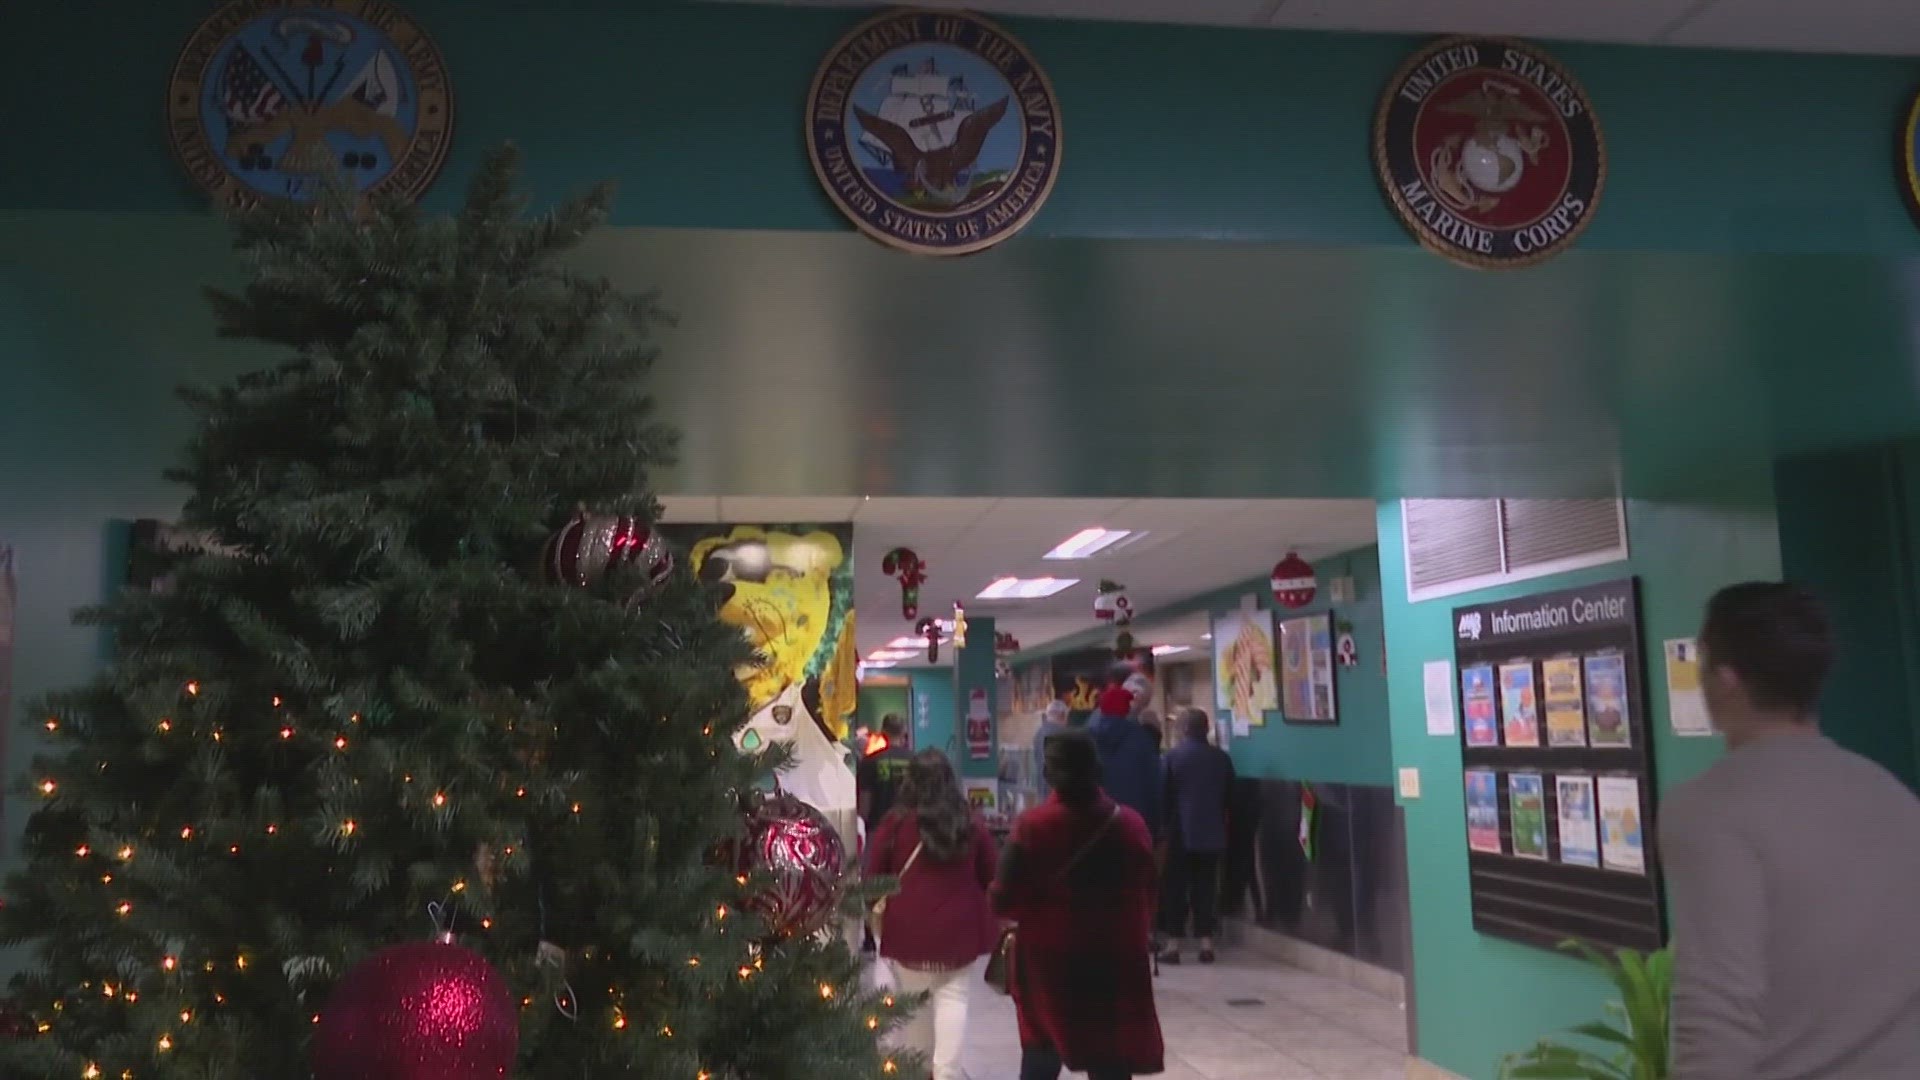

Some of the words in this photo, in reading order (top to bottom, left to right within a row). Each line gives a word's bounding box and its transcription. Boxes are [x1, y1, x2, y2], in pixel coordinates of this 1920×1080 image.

[817, 17, 921, 121] DEPARTMENT
[934, 17, 962, 42] OF
[978, 29, 1018, 74] THE
[1016, 71, 1055, 139] NAVY
[1399, 44, 1479, 103] UNITED
[1501, 48, 1584, 119] STATES
[824, 145, 878, 217] UNITED
[879, 208, 948, 241] STATES
[956, 219, 980, 240] OF
[985, 160, 1049, 231] AMERICA
[1400, 180, 1495, 255] MARINE
[1513, 191, 1586, 254] CORPS
[1491, 603, 1569, 635] Information
[1572, 596, 1627, 624] Center
